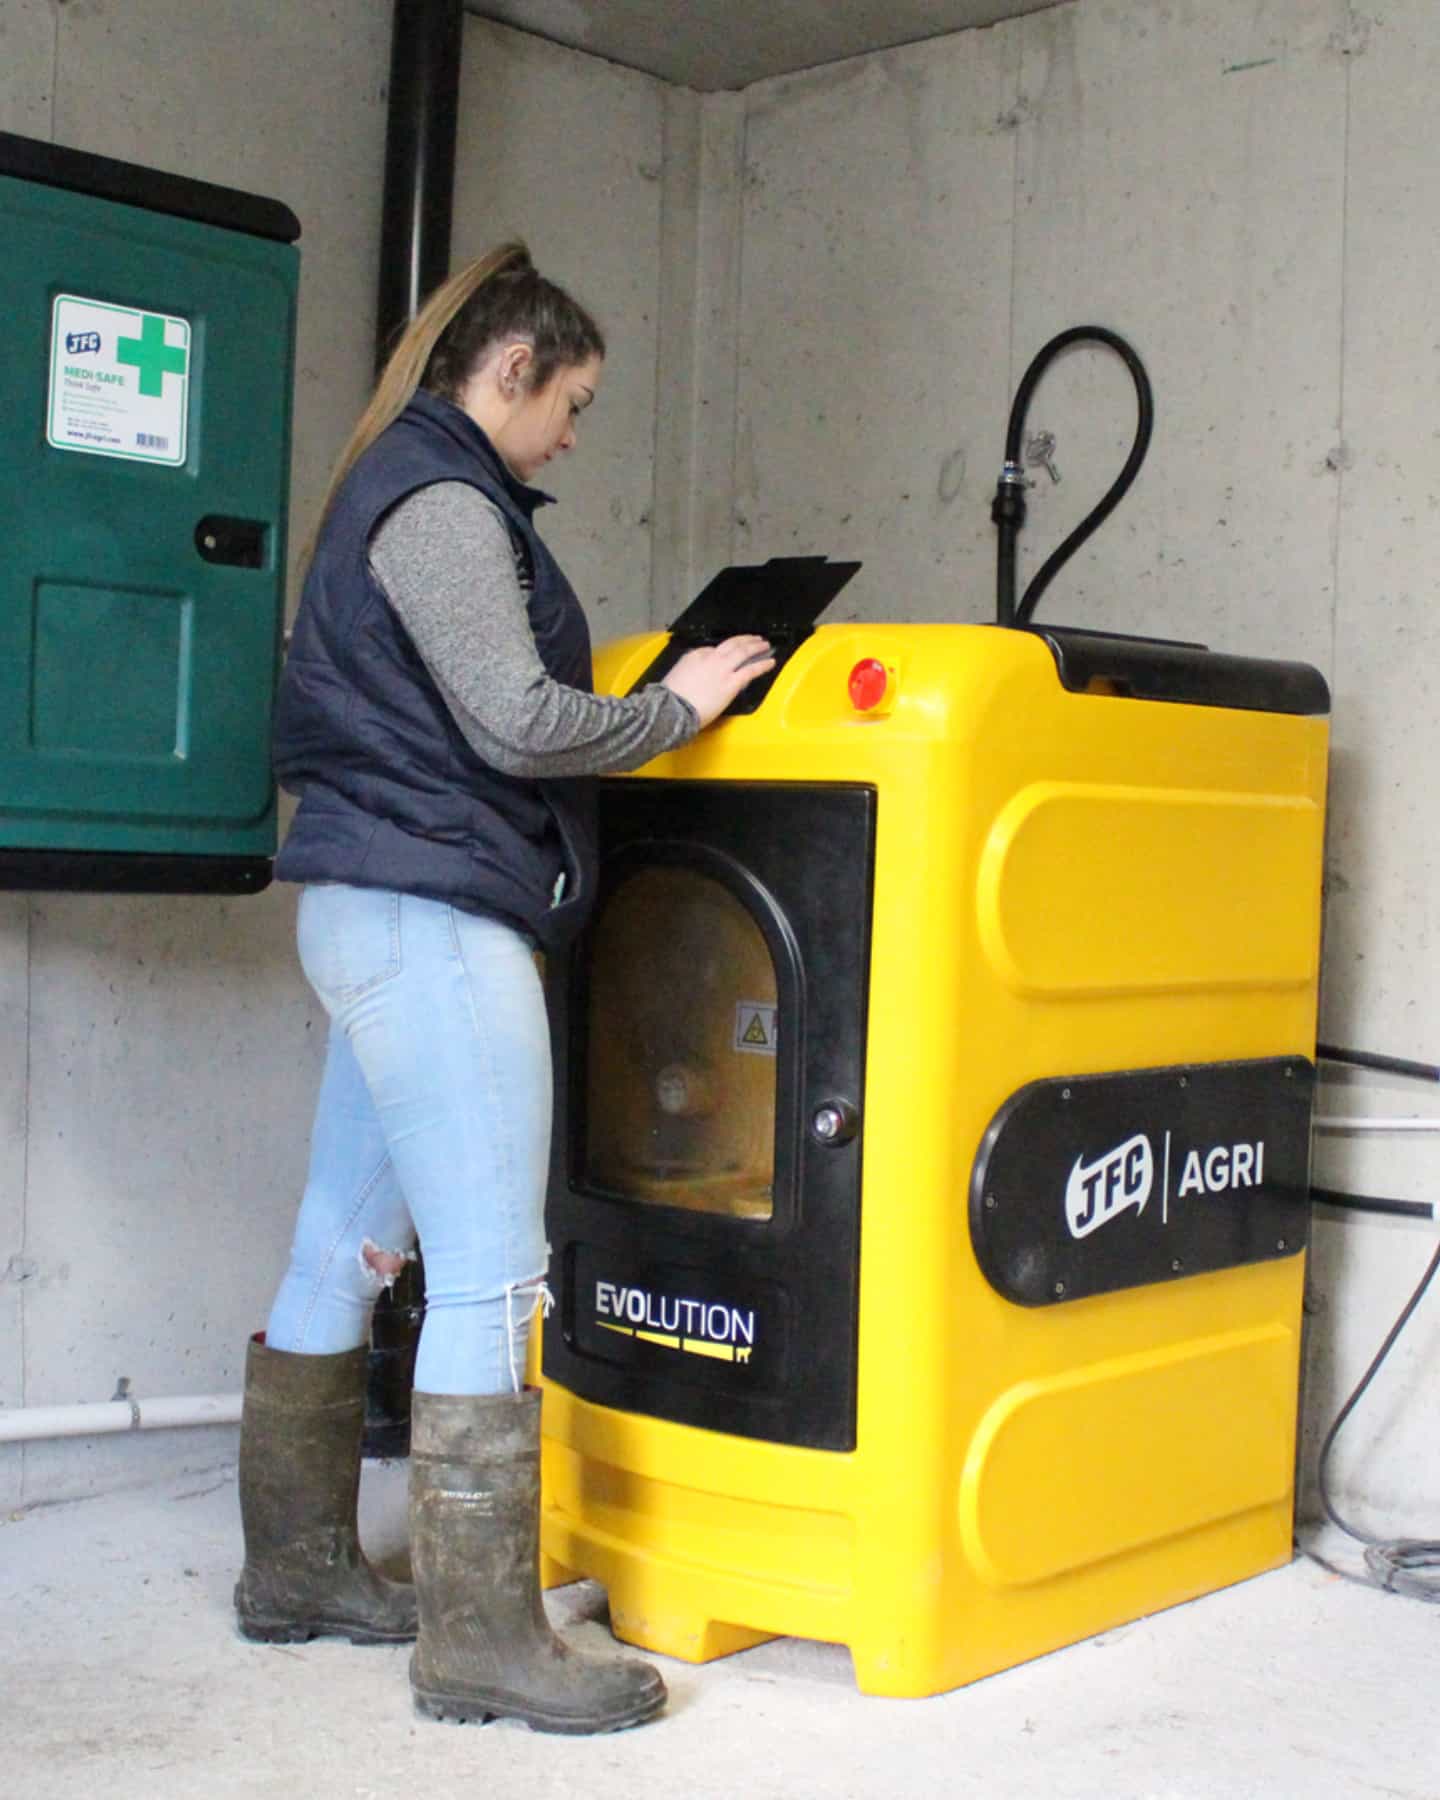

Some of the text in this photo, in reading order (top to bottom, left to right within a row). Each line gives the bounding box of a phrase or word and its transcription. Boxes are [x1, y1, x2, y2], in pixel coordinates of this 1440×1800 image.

[68, 332, 99, 353] JFC
[96, 371, 125, 386] SAFE
[1073, 1141, 1265, 1232] JFC AGRI
[596, 1281, 754, 1344] EVOLUTION
